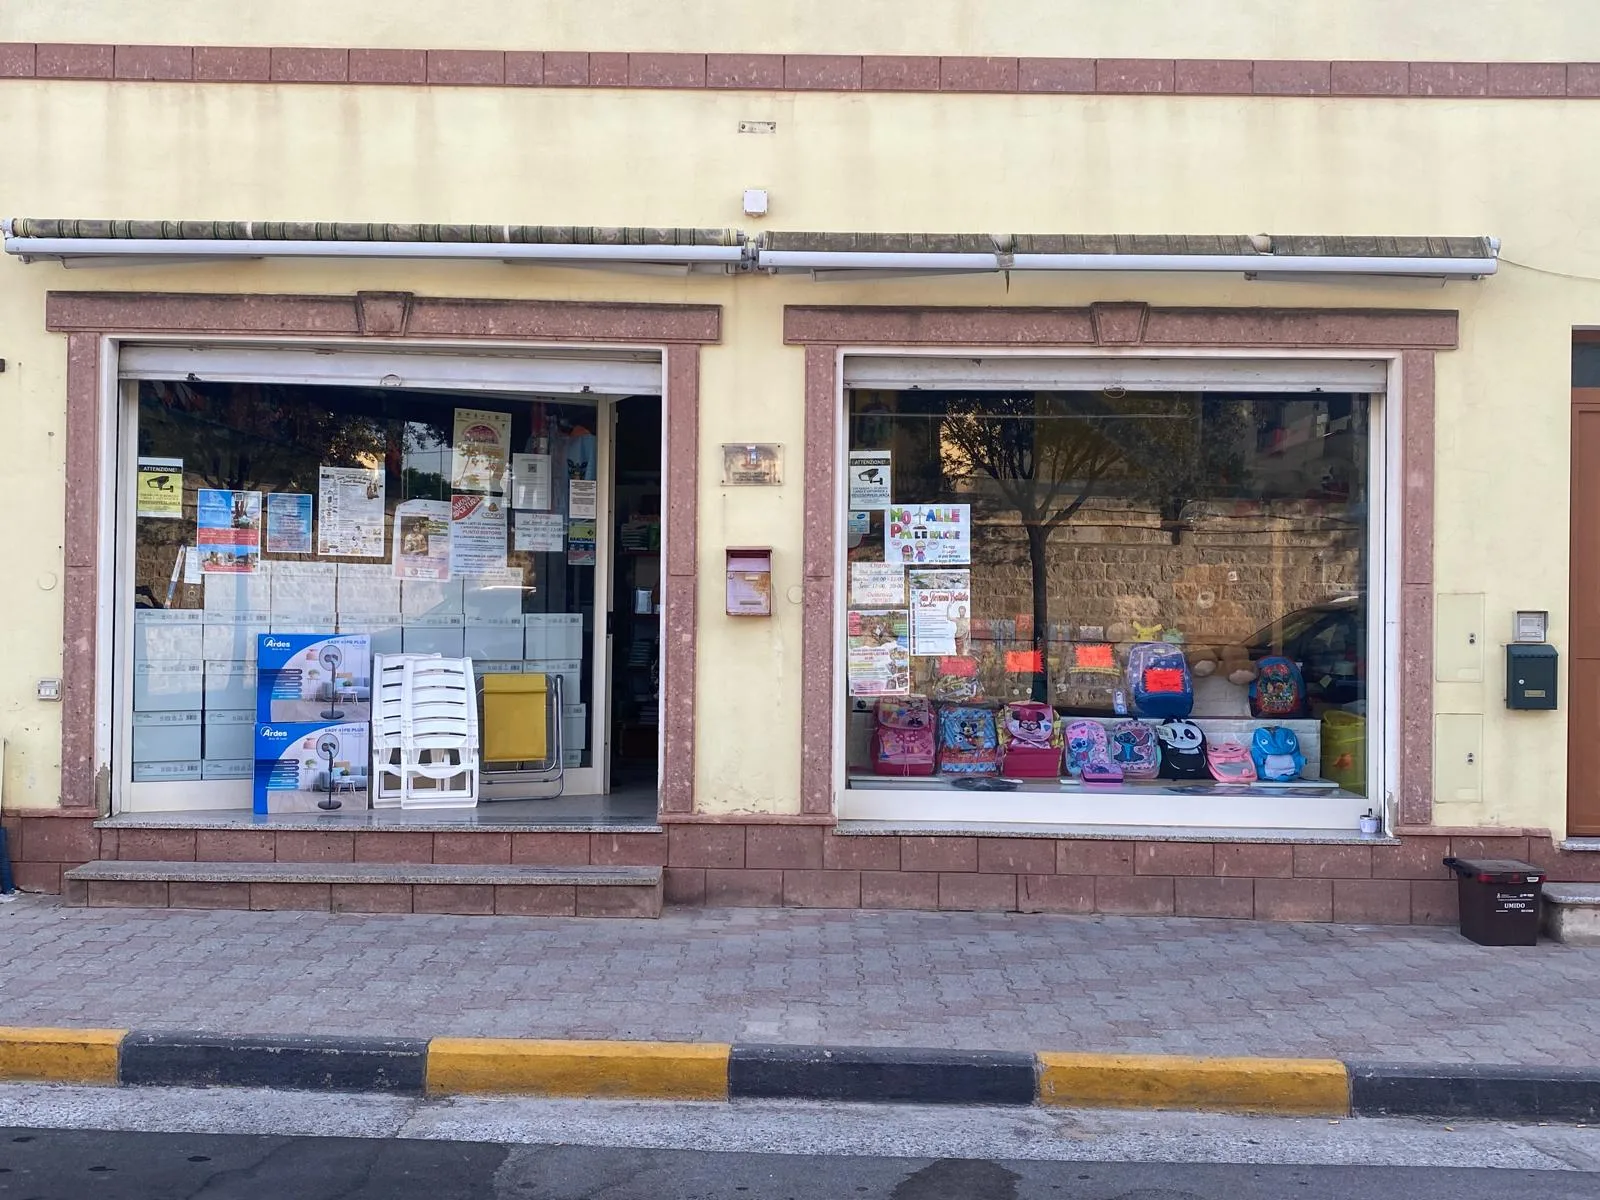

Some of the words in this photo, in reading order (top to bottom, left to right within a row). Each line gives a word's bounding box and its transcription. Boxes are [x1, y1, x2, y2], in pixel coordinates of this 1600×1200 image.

[890, 507, 912, 525] NO
[926, 508, 960, 522] ALLE
[890, 523, 927, 539] PALE
[265, 639, 291, 648] Ardes
[262, 728, 288, 737] Ardes
